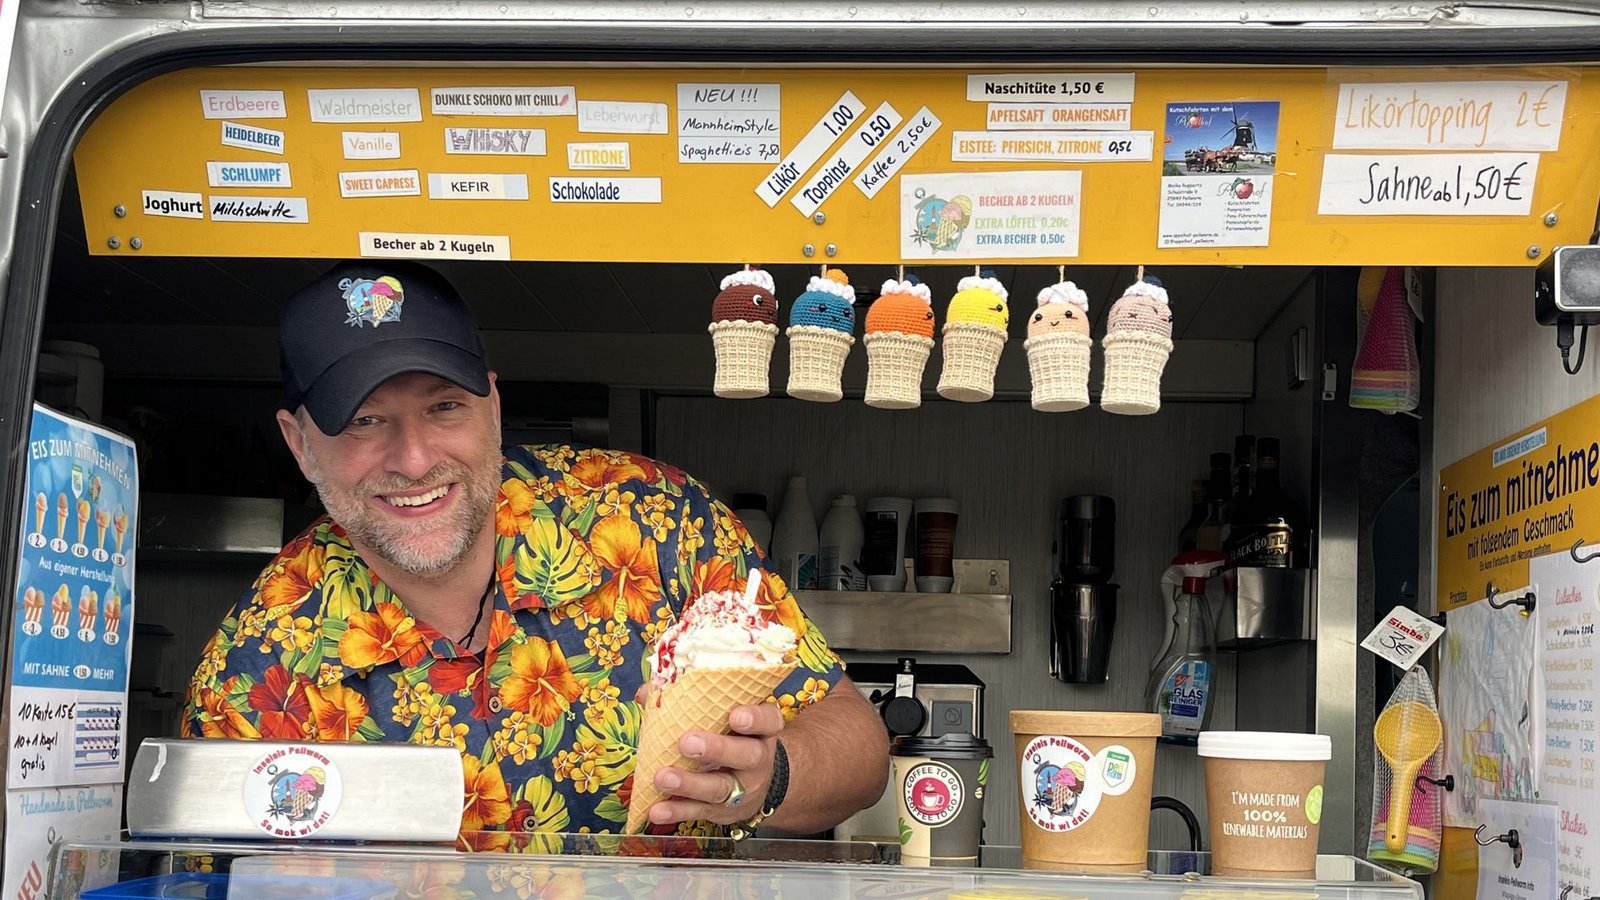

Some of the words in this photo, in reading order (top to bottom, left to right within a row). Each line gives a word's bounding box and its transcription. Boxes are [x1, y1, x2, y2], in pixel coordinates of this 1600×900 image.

[694, 88, 735, 103] NEU
[984, 81, 1056, 95] Naschitüte
[1061, 82, 1091, 96] 1,50
[1095, 82, 1104, 94] €
[208, 96, 280, 112] Erdbeere
[318, 99, 413, 117] Waldmeister
[435, 94, 471, 106] DUNKLE
[473, 94, 513, 106] SCHOKO
[514, 94, 532, 106] MIT
[533, 94, 559, 106] CHILI
[585, 107, 661, 125] Leberwurst
[990, 109, 1045, 123] APFELSAFT
[1052, 108, 1128, 123] ORANGENSAFT
[1345, 88, 1493, 147] Likörtopping
[225, 126, 281, 147] HEIDELBEER
[349, 137, 393, 151] Vanille
[573, 148, 625, 165] ZITRONE
[681, 144, 751, 161] Spaghettieis
[758, 143, 780, 160] 7,50
[767, 161, 801, 197] Likör
[823, 104, 855, 137] 1,00
[959, 141, 997, 154] EISTEE:
[1002, 141, 1055, 155] PFIRSICH,
[1057, 140, 1103, 153] ZITRONE
[802, 157, 851, 206] Topping
[861, 114, 892, 148] 0,50
[221, 167, 282, 182] SCHLUMPF
[861, 155, 896, 190] Kaffee
[345, 178, 374, 191] SWEET
[375, 176, 415, 190] CAPRESE
[451, 182, 490, 193] KEFIR
[552, 181, 620, 200] Schokolade
[1359, 162, 1432, 205] Sahne
[1433, 181, 1451, 201] ab
[144, 196, 203, 214] Joghurt
[979, 195, 1015, 207] BECHER
[1016, 195, 1029, 207] AB
[1030, 195, 1037, 207] 2
[1038, 194, 1074, 206] KUGELN
[975, 218, 1003, 230] EXTRA
[1005, 215, 1037, 229] LÖFFEL
[373, 237, 416, 251] Becher
[419, 240, 436, 252] ab
[439, 240, 447, 252] 2
[450, 240, 495, 255] Kugeln
[976, 234, 1003, 245] EXTRA
[1004, 233, 1036, 245] BECHER
[31, 439, 48, 460] EIS
[50, 439, 73, 458] ZUM
[74, 441, 131, 491] MITNEHMEN
[1446, 490, 1466, 539] Eis
[1470, 482, 1501, 530] zum
[1467, 535, 1480, 560] mit
[1480, 525, 1519, 557] folgendem
[1523, 503, 1575, 543] Geschmack
[39, 556, 52, 570] Aus
[54, 560, 79, 576] eigener
[80, 565, 115, 584] Herstellung
[1387, 617, 1424, 641] Simba
[24, 662, 41, 675] MIT
[41, 663, 70, 677] SAHNE
[93, 668, 115, 680] MEHR
[1173, 687, 1204, 700] GLAS
[18, 702, 32, 721] 10
[1050, 737, 1091, 762] Pellworm
[21, 755, 46, 780] gratis
[906, 766, 933, 788] COFFEE
[936, 767, 948, 778] TO
[947, 777, 959, 791] GO
[19, 791, 65, 816] Handmade
[66, 795, 76, 811] in
[76, 789, 113, 813] Pellworm
[906, 795, 934, 821] COFFEE
[936, 810, 948, 820] TO
[947, 798, 958, 812] GO
[1231, 791, 1248, 806] I'M
[1249, 792, 1276, 807] MADE
[1276, 793, 1300, 807] FROM
[1038, 819, 1056, 830] mok
[1243, 809, 1287, 823] 100%
[260, 819, 273, 831] So
[274, 828, 297, 837] mok
[1222, 822, 1265, 838] RENEWABLE
[1266, 825, 1308, 839] MATERIALS
